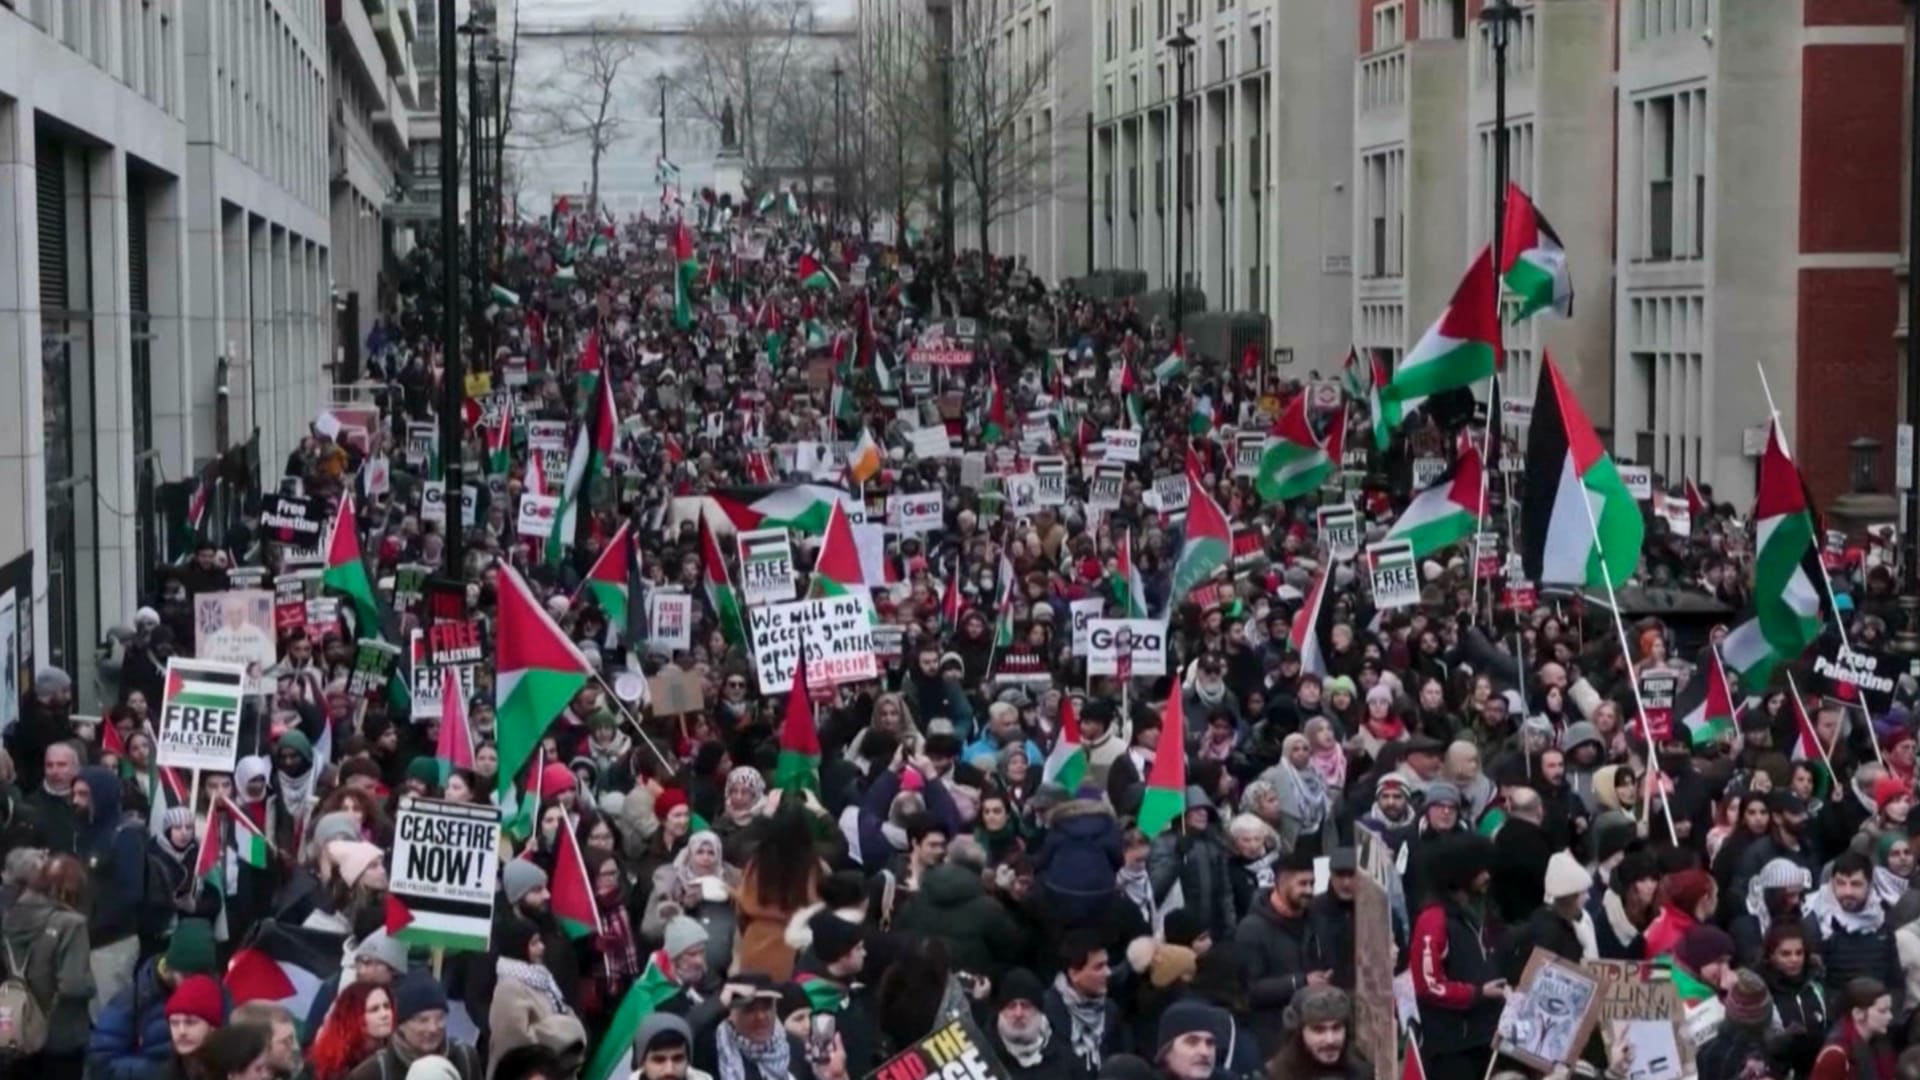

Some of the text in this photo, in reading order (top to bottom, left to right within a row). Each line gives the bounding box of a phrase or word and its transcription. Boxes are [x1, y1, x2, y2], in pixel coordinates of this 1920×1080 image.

[911, 352, 973, 364] GENOCIDE
[278, 499, 306, 517] Free
[261, 512, 319, 533] Palestine
[745, 559, 791, 577] FREE
[1373, 566, 1415, 587] FREE
[752, 601, 862, 631] We will not
[430, 622, 479, 650] FREE
[822, 621, 856, 642] your
[433, 647, 481, 665] PALESTINE
[1837, 644, 1876, 672] Free
[414, 667, 471, 688] FRE
[763, 654, 870, 686] the GENOCIDE
[1814, 656, 1895, 693] Palestine
[163, 706, 236, 736] FREE
[162, 731, 233, 749] PALESTINE
[400, 815, 496, 852] CEASEFIRE
[875, 1021, 975, 1080] END THE
